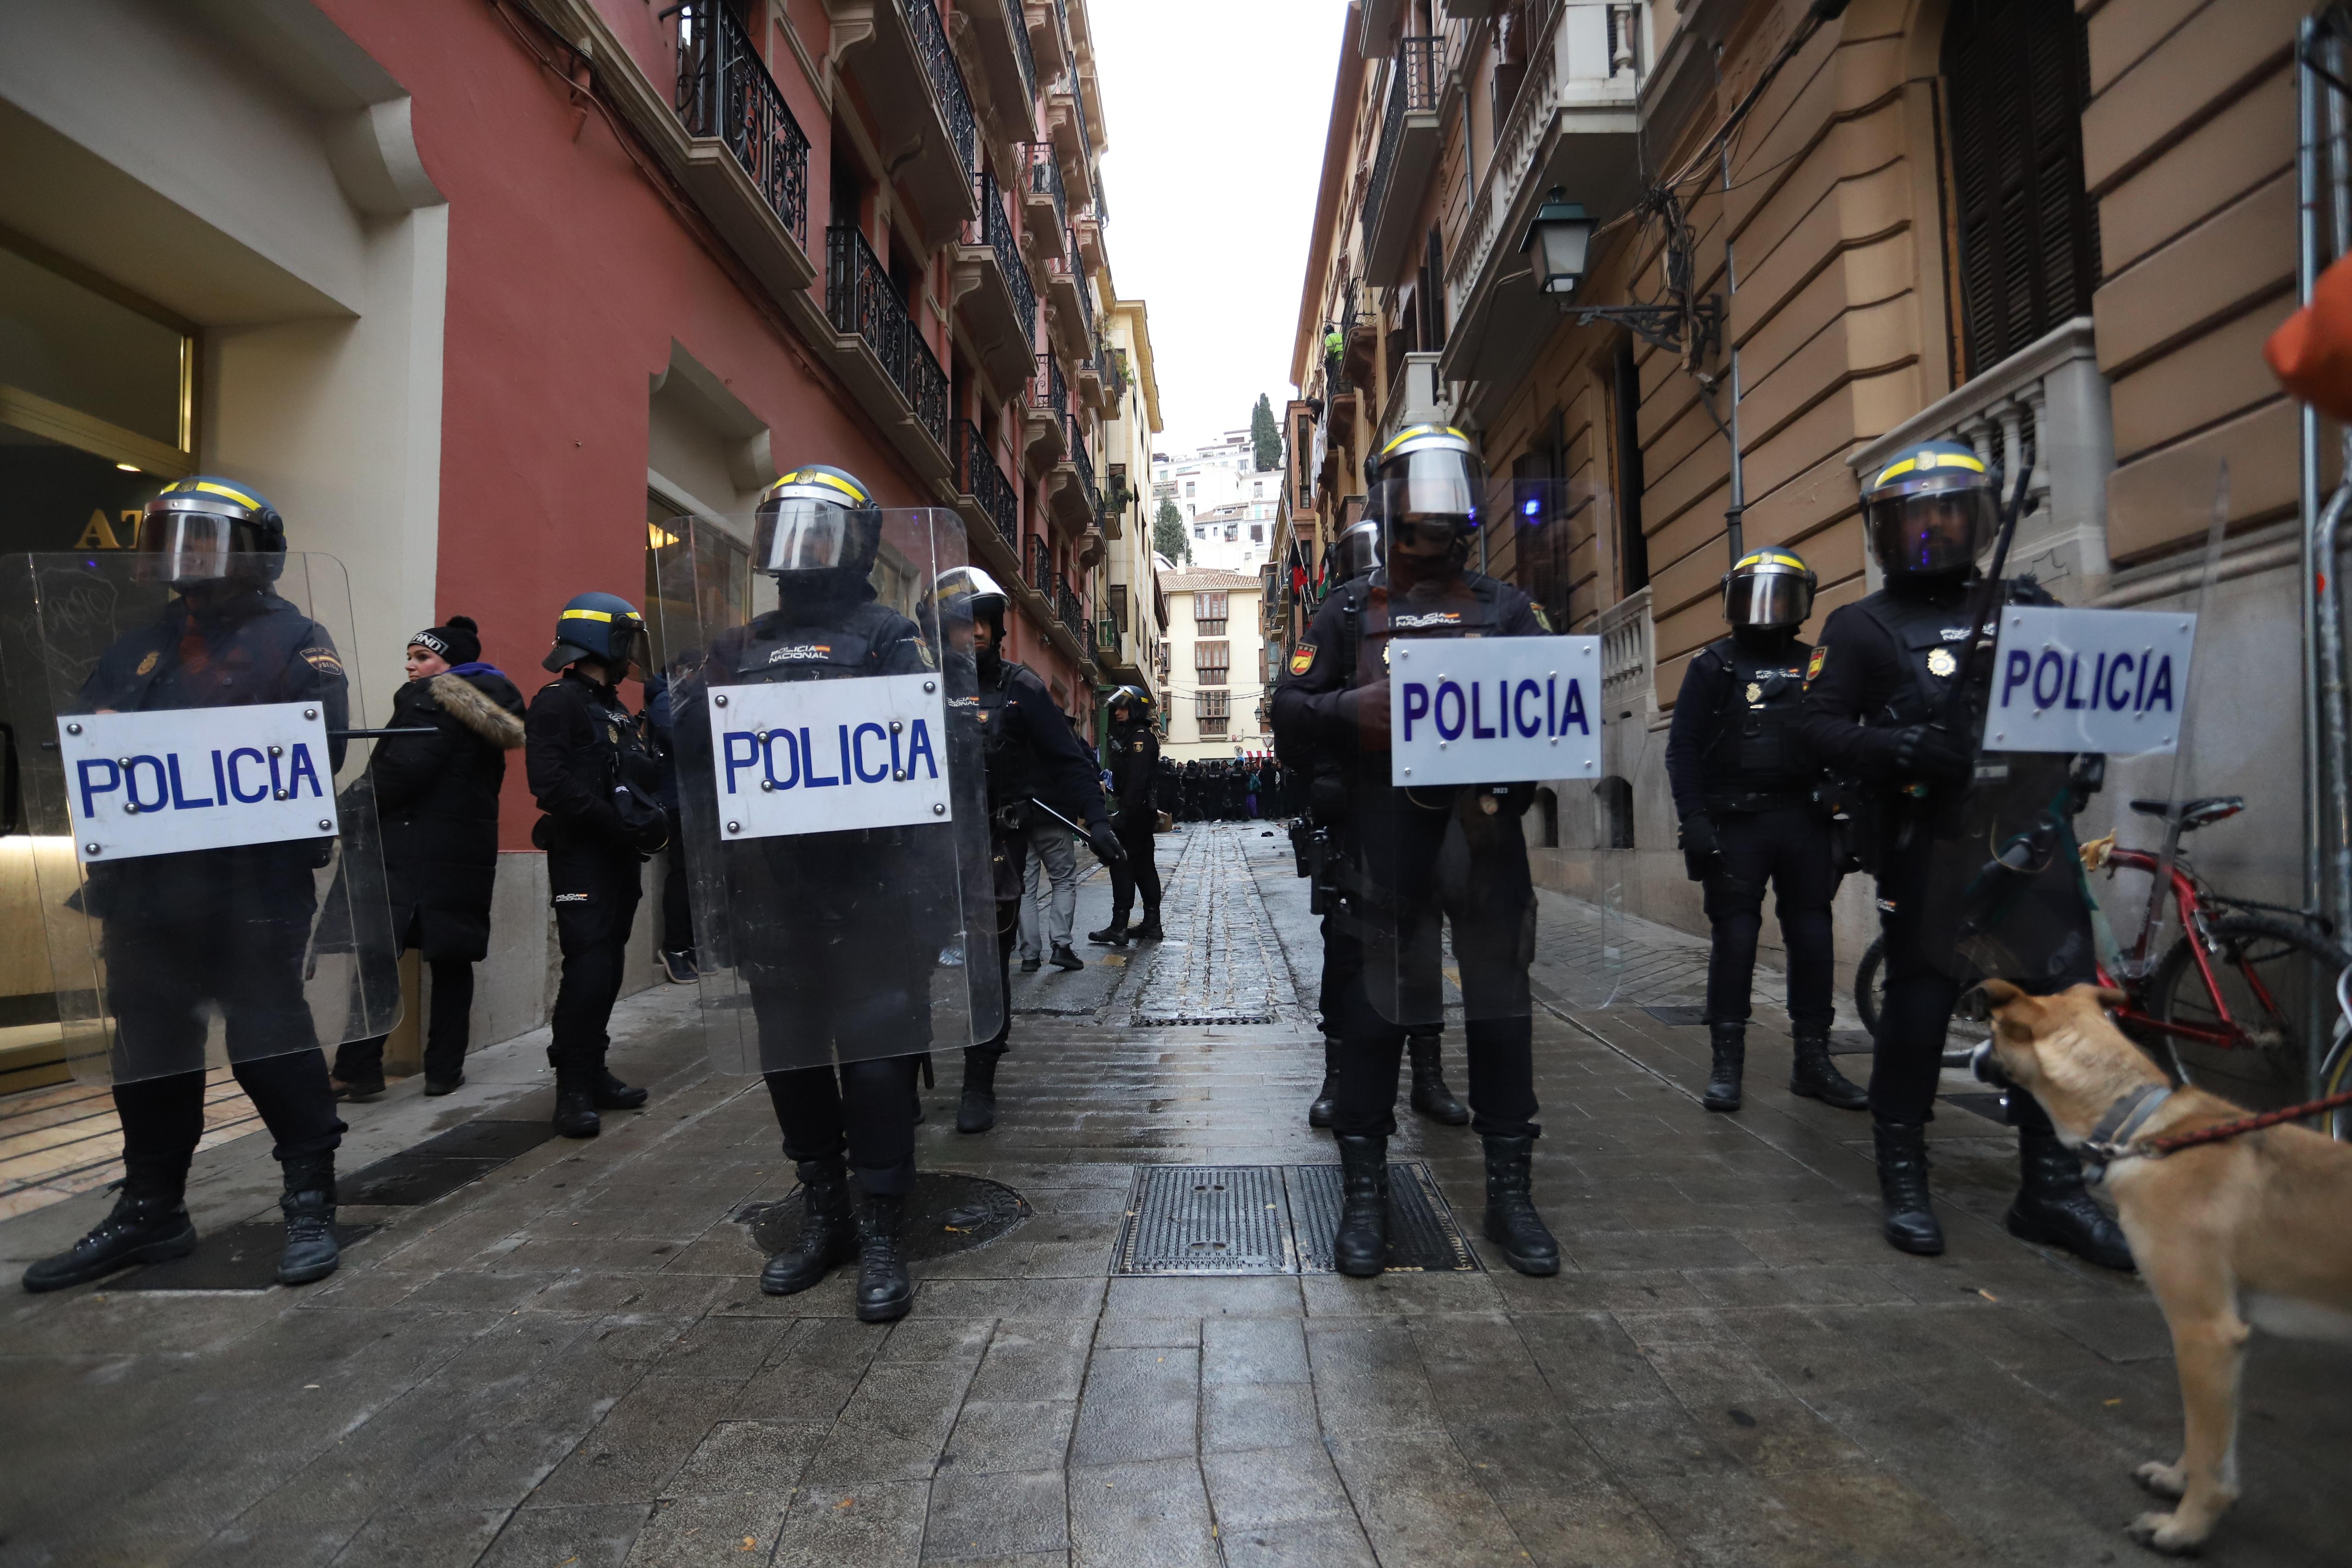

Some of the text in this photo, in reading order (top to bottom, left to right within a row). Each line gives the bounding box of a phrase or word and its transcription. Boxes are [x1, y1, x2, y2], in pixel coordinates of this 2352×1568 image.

[1396, 612, 1445, 622] POLICIA
[1396, 618, 1461, 627] NACIONAL
[413, 633, 441, 651] AND
[770, 645, 816, 657] POLICIA
[769, 652, 829, 664] NACIONAL
[2001, 649, 2172, 712] POLICIA
[1403, 678, 1589, 742] POLICIA
[723, 719, 939, 794] POLICIA
[77, 743, 323, 818] POLICIA
